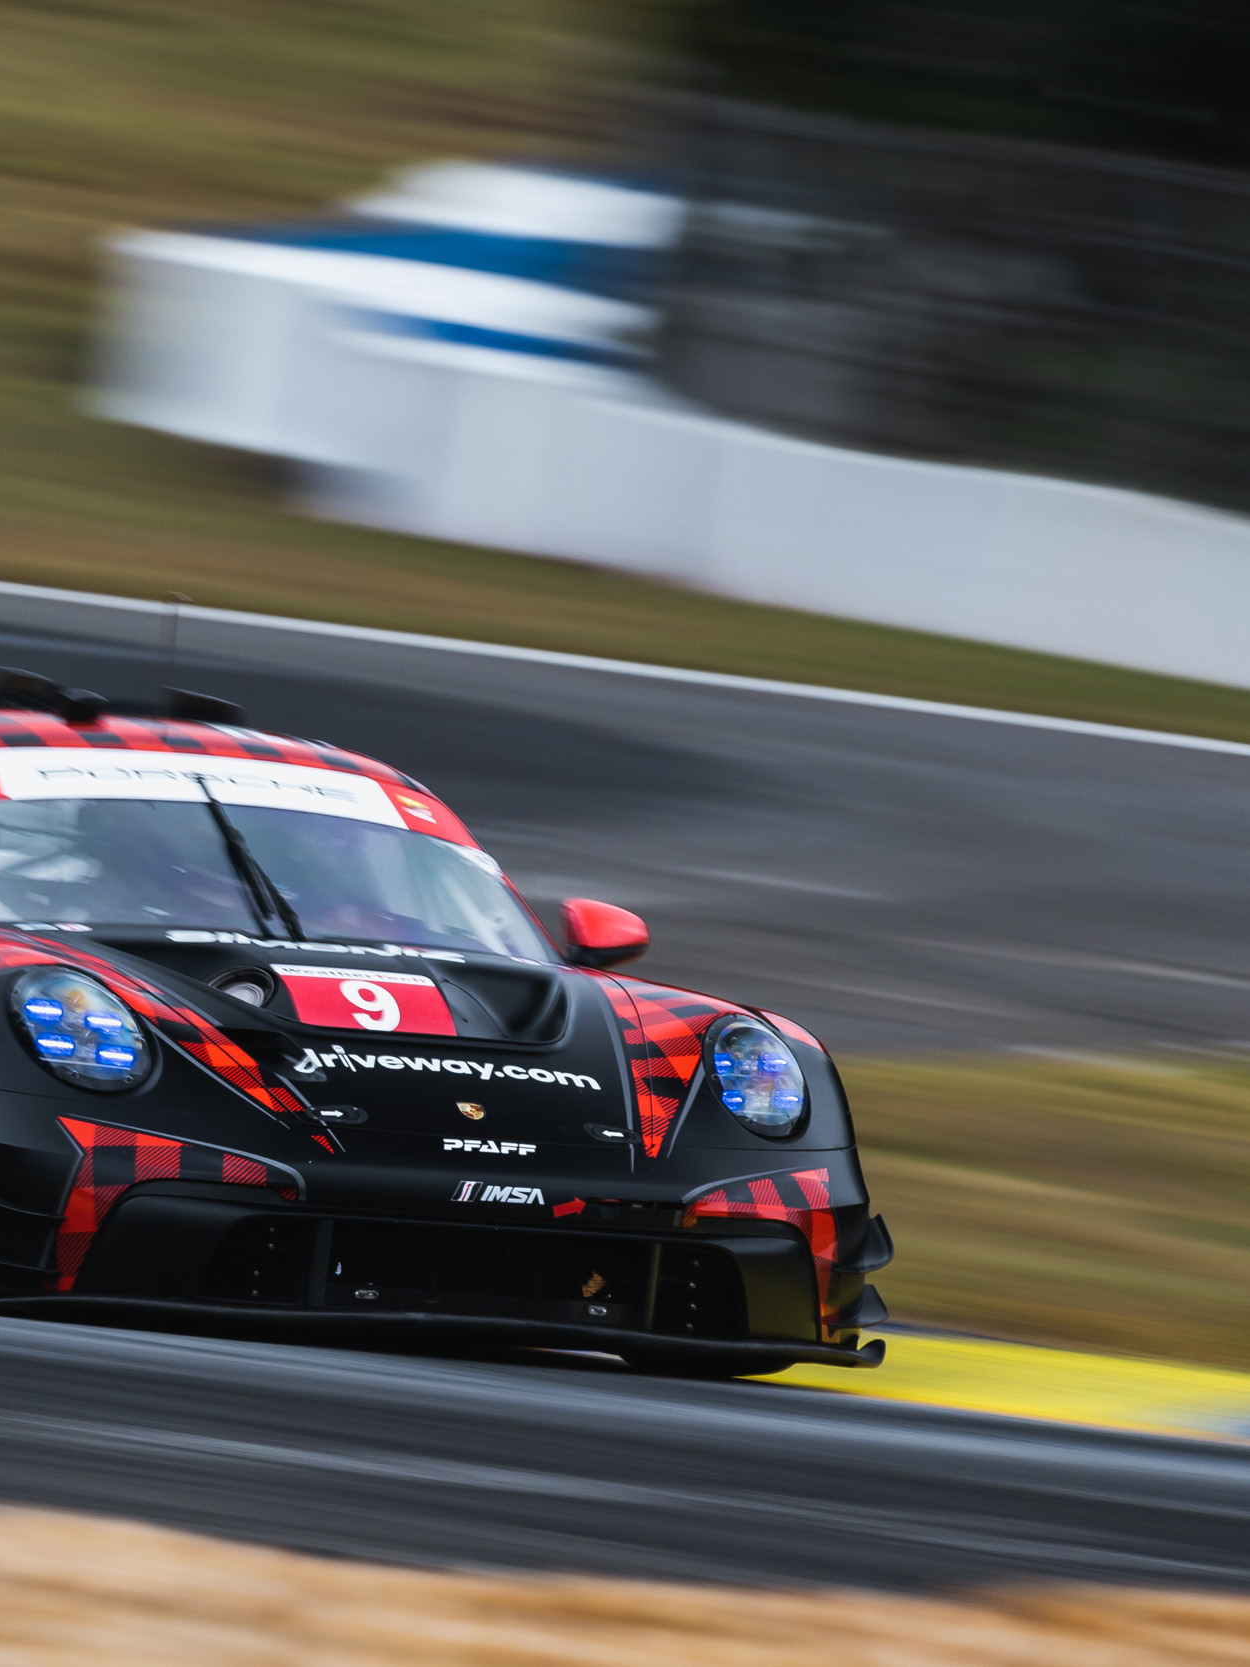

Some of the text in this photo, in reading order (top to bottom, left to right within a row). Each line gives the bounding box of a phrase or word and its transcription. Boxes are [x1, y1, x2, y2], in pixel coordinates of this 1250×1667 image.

[339, 980, 401, 1032] 9
[293, 1045, 601, 1090] driveway.com
[443, 1138, 537, 1155] PFAFF
[480, 1185, 546, 1205] IMSA
